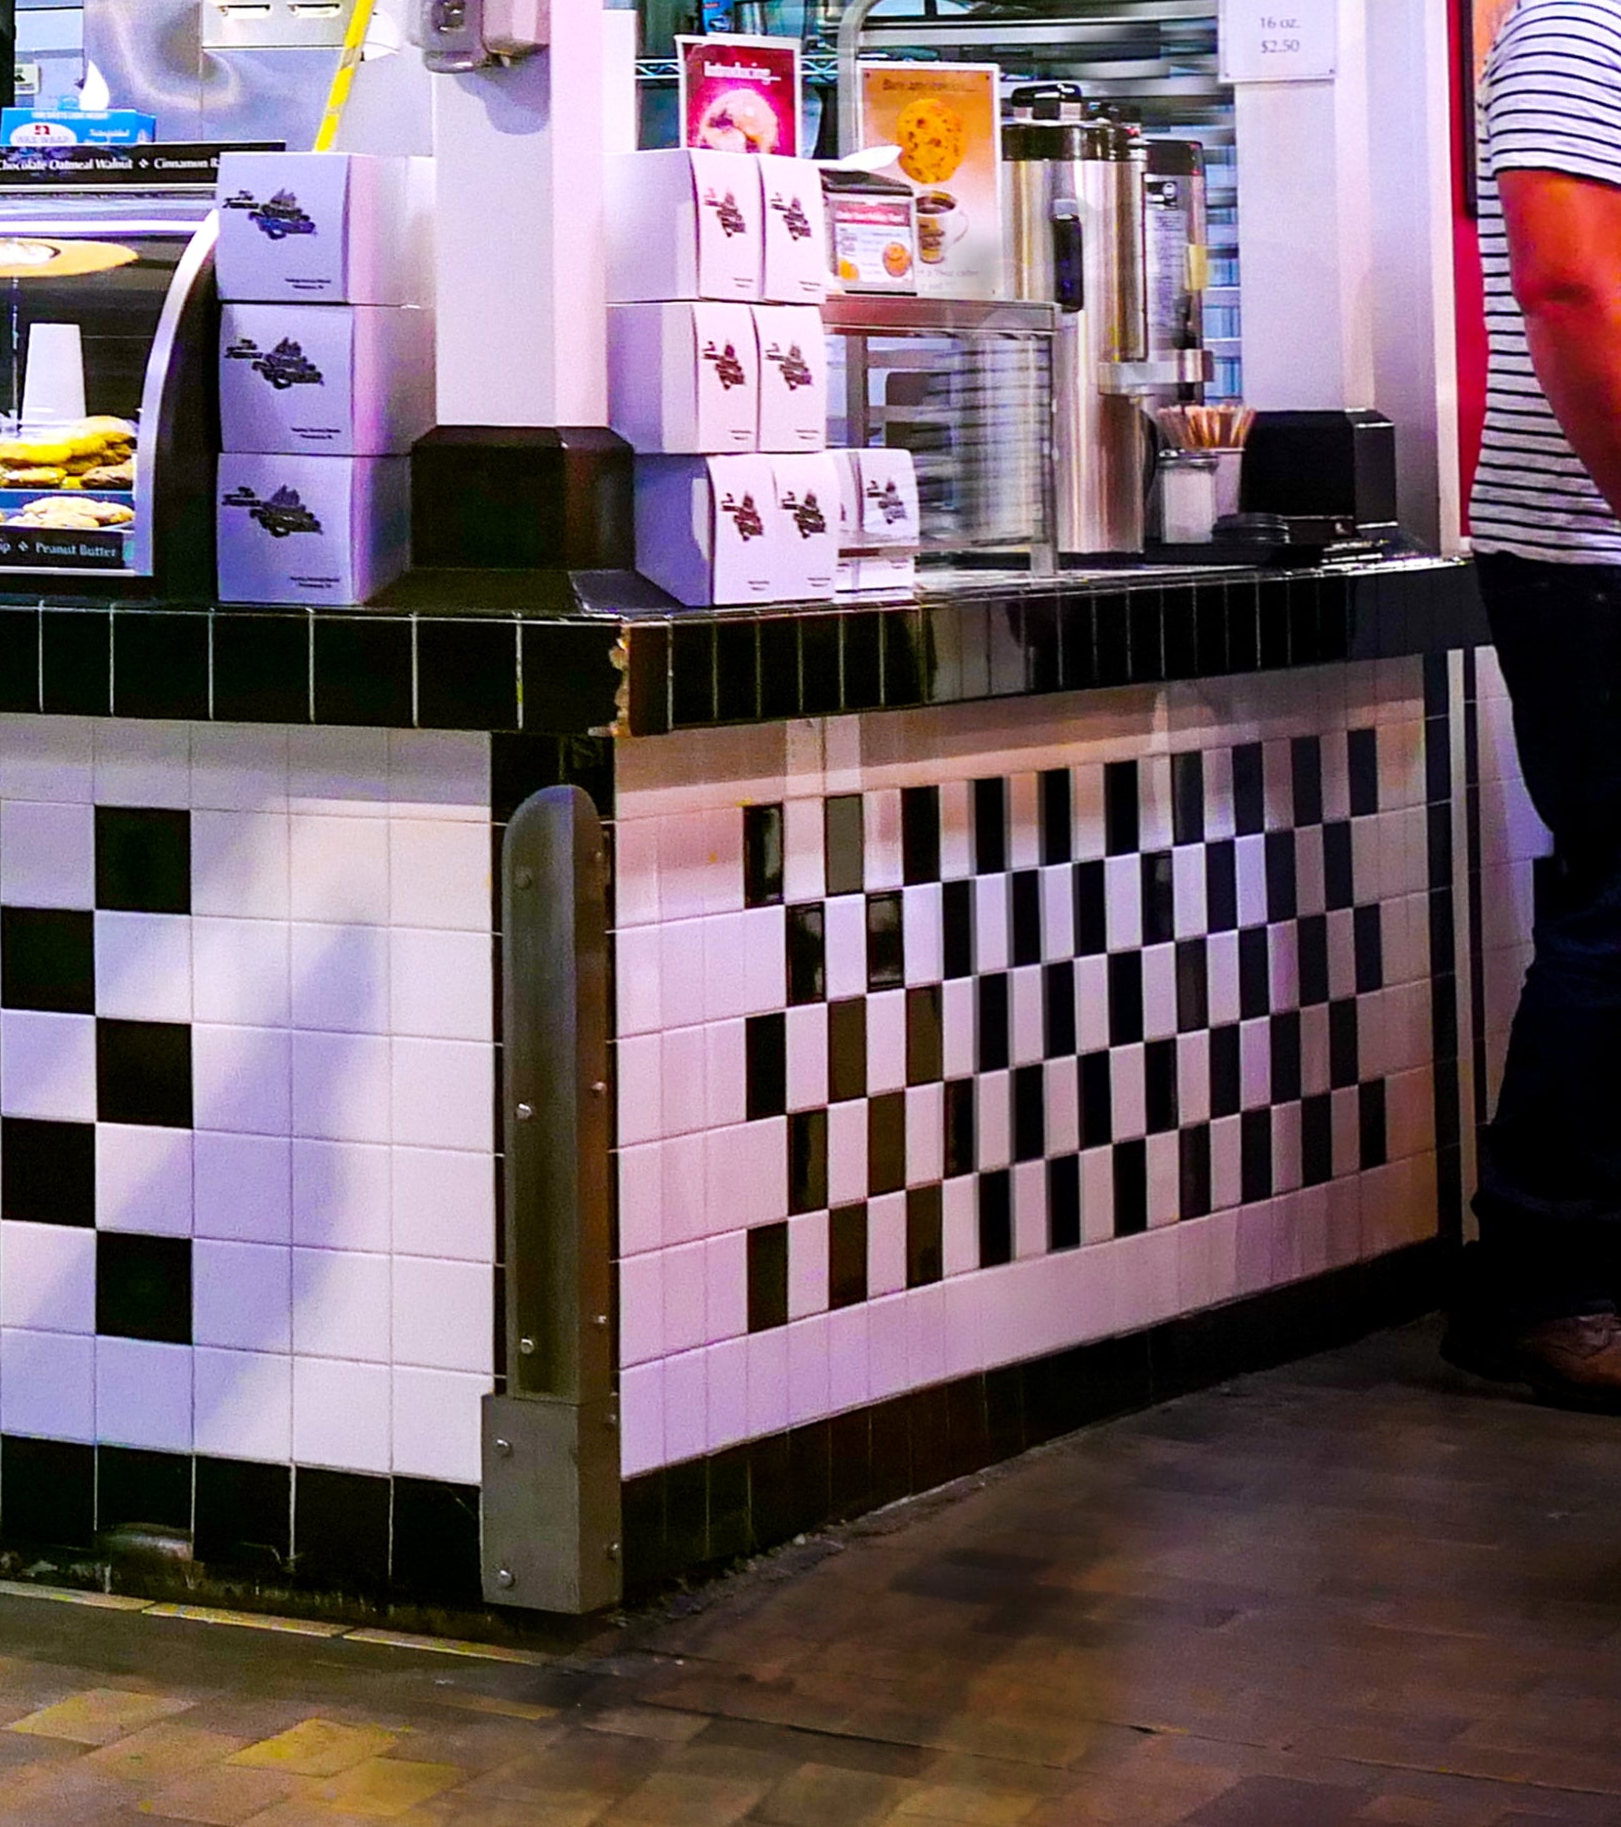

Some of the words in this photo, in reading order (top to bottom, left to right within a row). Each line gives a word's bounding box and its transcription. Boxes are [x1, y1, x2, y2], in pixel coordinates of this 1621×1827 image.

[1260, 17, 1277, 30] 16
[1280, 18, 1301, 30] oz.
[1260, 39, 1300, 54] $2.50
[35, 540, 76, 555] Peanut
[79, 543, 117, 557] Butter
